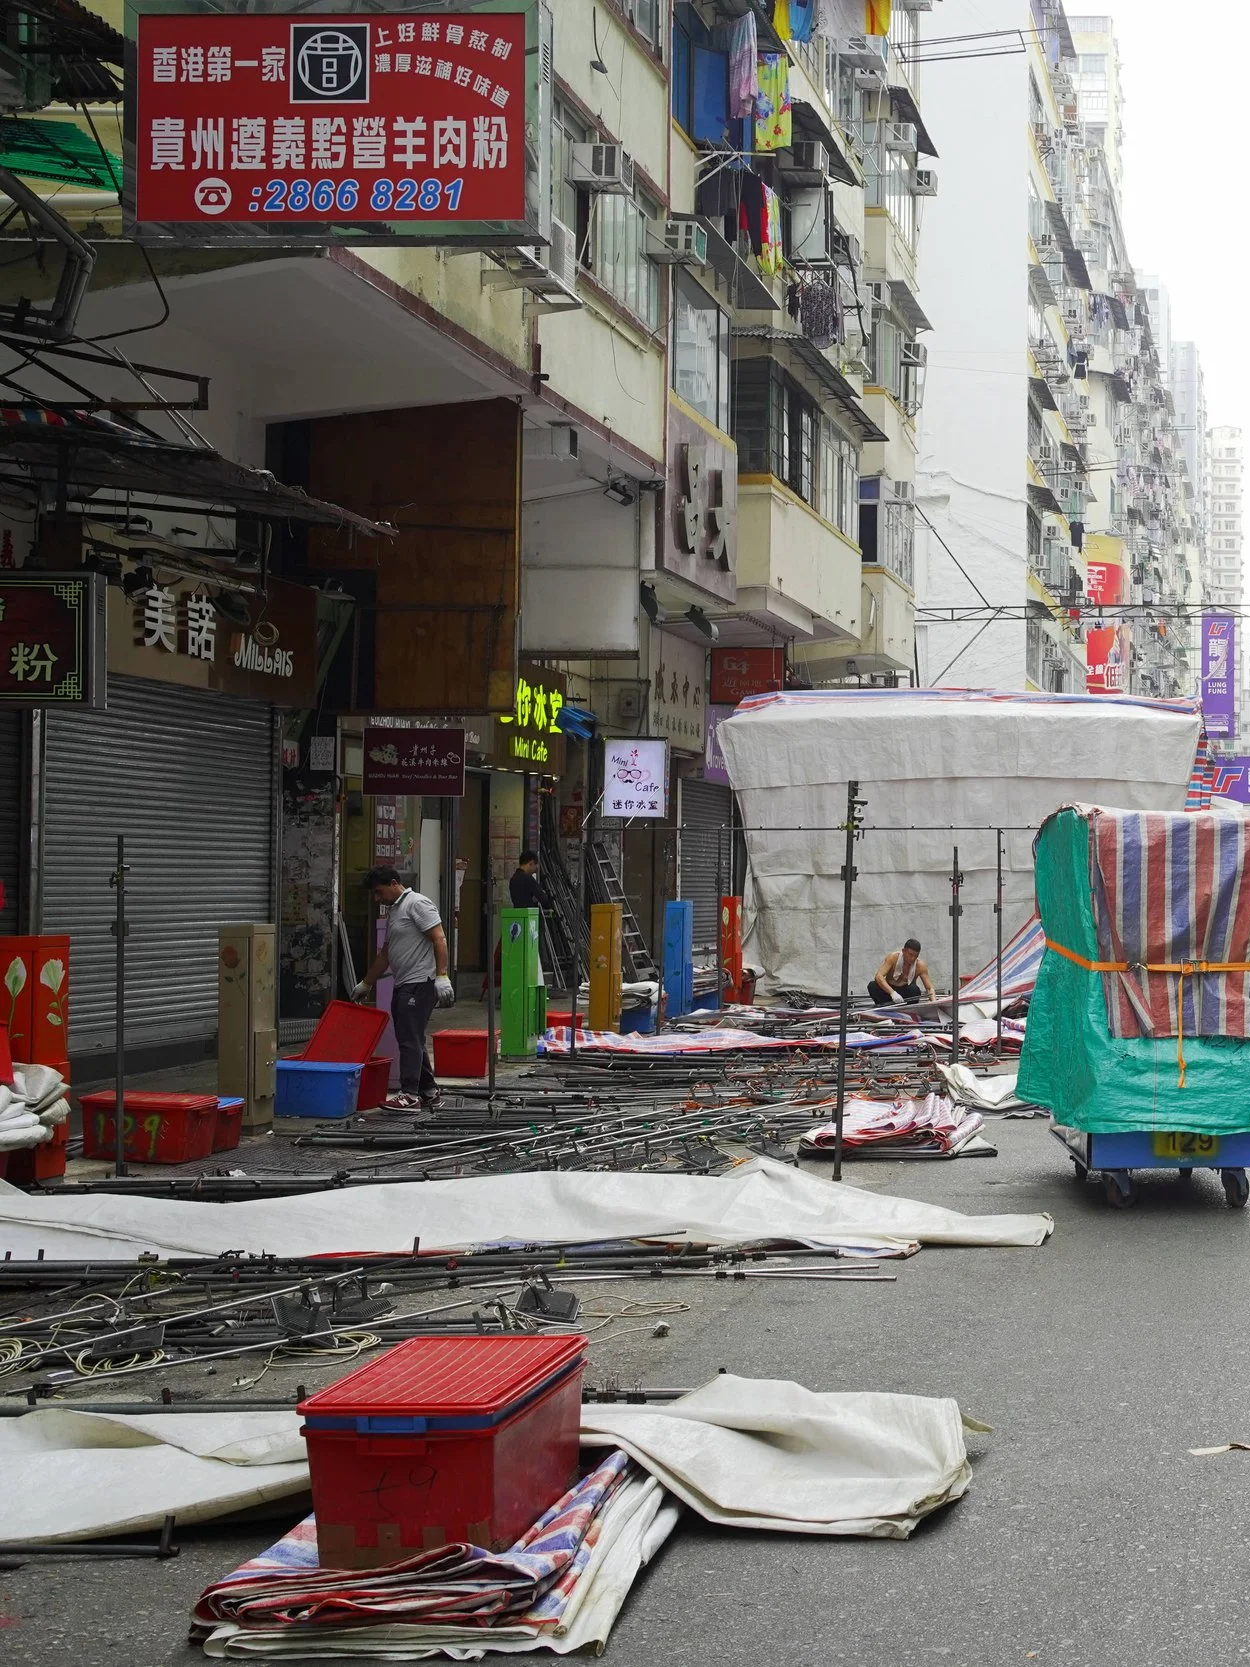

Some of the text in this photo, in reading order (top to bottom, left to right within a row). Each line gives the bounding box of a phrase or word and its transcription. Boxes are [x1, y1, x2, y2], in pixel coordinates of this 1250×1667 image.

[375, 22, 512, 61] 上好鮮骨熬制
[152, 45, 286, 83] 香港第一家
[375, 53, 511, 109] 濃厚滋補好味道
[150, 115, 509, 171] 貴州遵義黔營羊肉粉
[369, 177, 464, 212] 8281
[144, 583, 217, 662] 美諾
[8, 642, 60, 682] 粉
[500, 677, 563, 734] 你冰室
[514, 736, 548, 763] Mini Cafe
[611, 755, 629, 767] Mini
[612, 799, 659, 811] 迷你冰室
[635, 781, 660, 793] Cafe
[1165, 1132, 1214, 1153] 129
